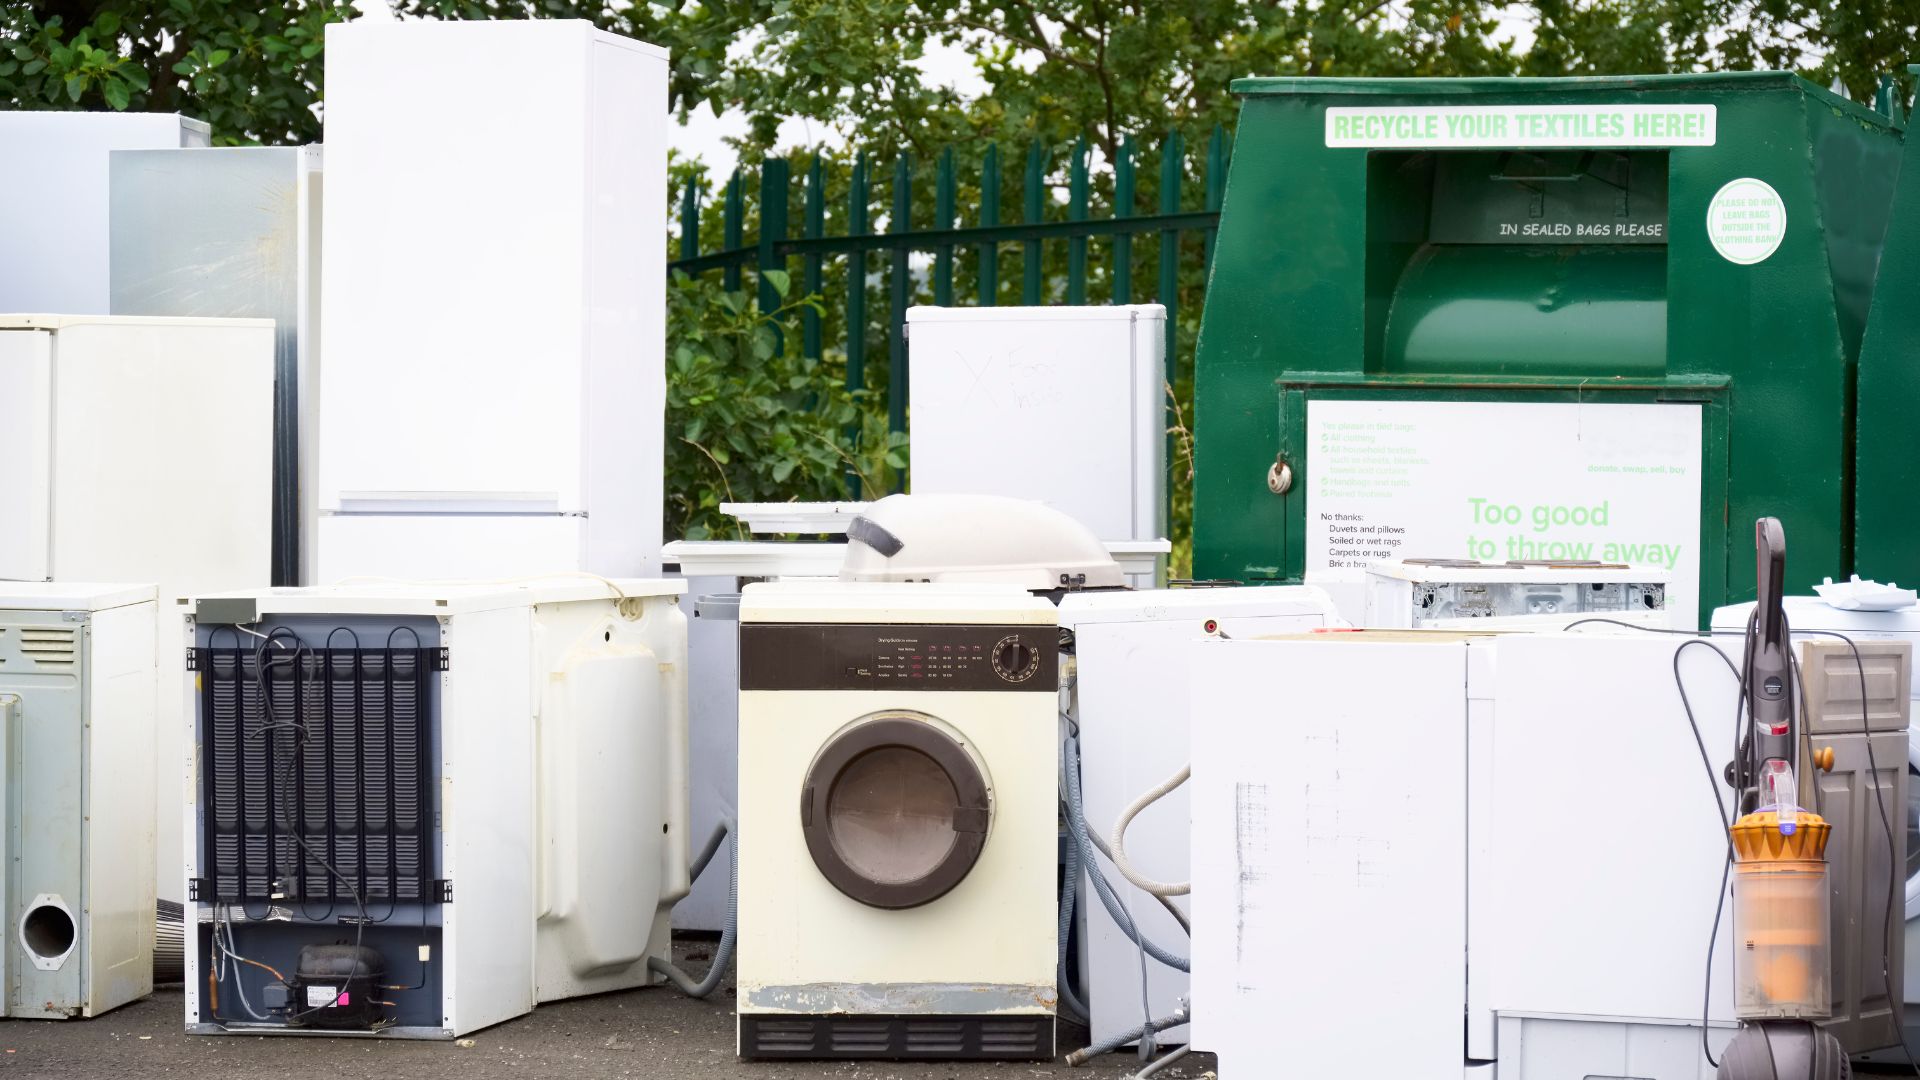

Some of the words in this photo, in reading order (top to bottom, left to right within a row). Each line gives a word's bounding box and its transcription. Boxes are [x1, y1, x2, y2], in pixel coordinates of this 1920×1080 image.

[1334, 115, 1438, 139] RECYCLE
[1445, 114, 1508, 138] YOUR
[1515, 113, 1625, 138] TEXTILES
[1633, 113, 1706, 138] HERE!
[1716, 199, 1746, 207] PLEASE
[1748, 199, 1758, 207] DO
[1761, 198, 1777, 206] NOT
[1723, 211, 1747, 219] LEAVE
[1749, 210, 1770, 219] BAGS
[1500, 223, 1518, 235] IN
[1522, 223, 1572, 236] SEALED
[1576, 223, 1611, 236] BAGS
[1615, 223, 1663, 236] PLEASE
[1722, 223, 1752, 232] OUTSIDE
[1756, 223, 1771, 231] THE
[1715, 235, 1753, 244] CLOTHING
[1755, 235, 1777, 243] BANK
[1587, 464, 1620, 473] donate,
[1669, 465, 1686, 475] buy
[1321, 513, 1332, 521] No
[1334, 513, 1364, 522] thanks:
[1468, 498, 1522, 525] Too
[1532, 501, 1609, 532] good
[1329, 525, 1358, 533] Duvets
[1360, 525, 1375, 534] and
[1377, 526, 1405, 535] pillows
[1329, 537, 1354, 545] Soiled
[1384, 538, 1402, 547] rags
[1329, 548, 1360, 557] Carpets
[1373, 550, 1391, 559] rugs
[1467, 536, 1496, 560] to
[1506, 535, 1593, 561] throw
[1603, 542, 1681, 570] away
[1329, 560, 1343, 568] Bric
[1353, 560, 1367, 568] bra
